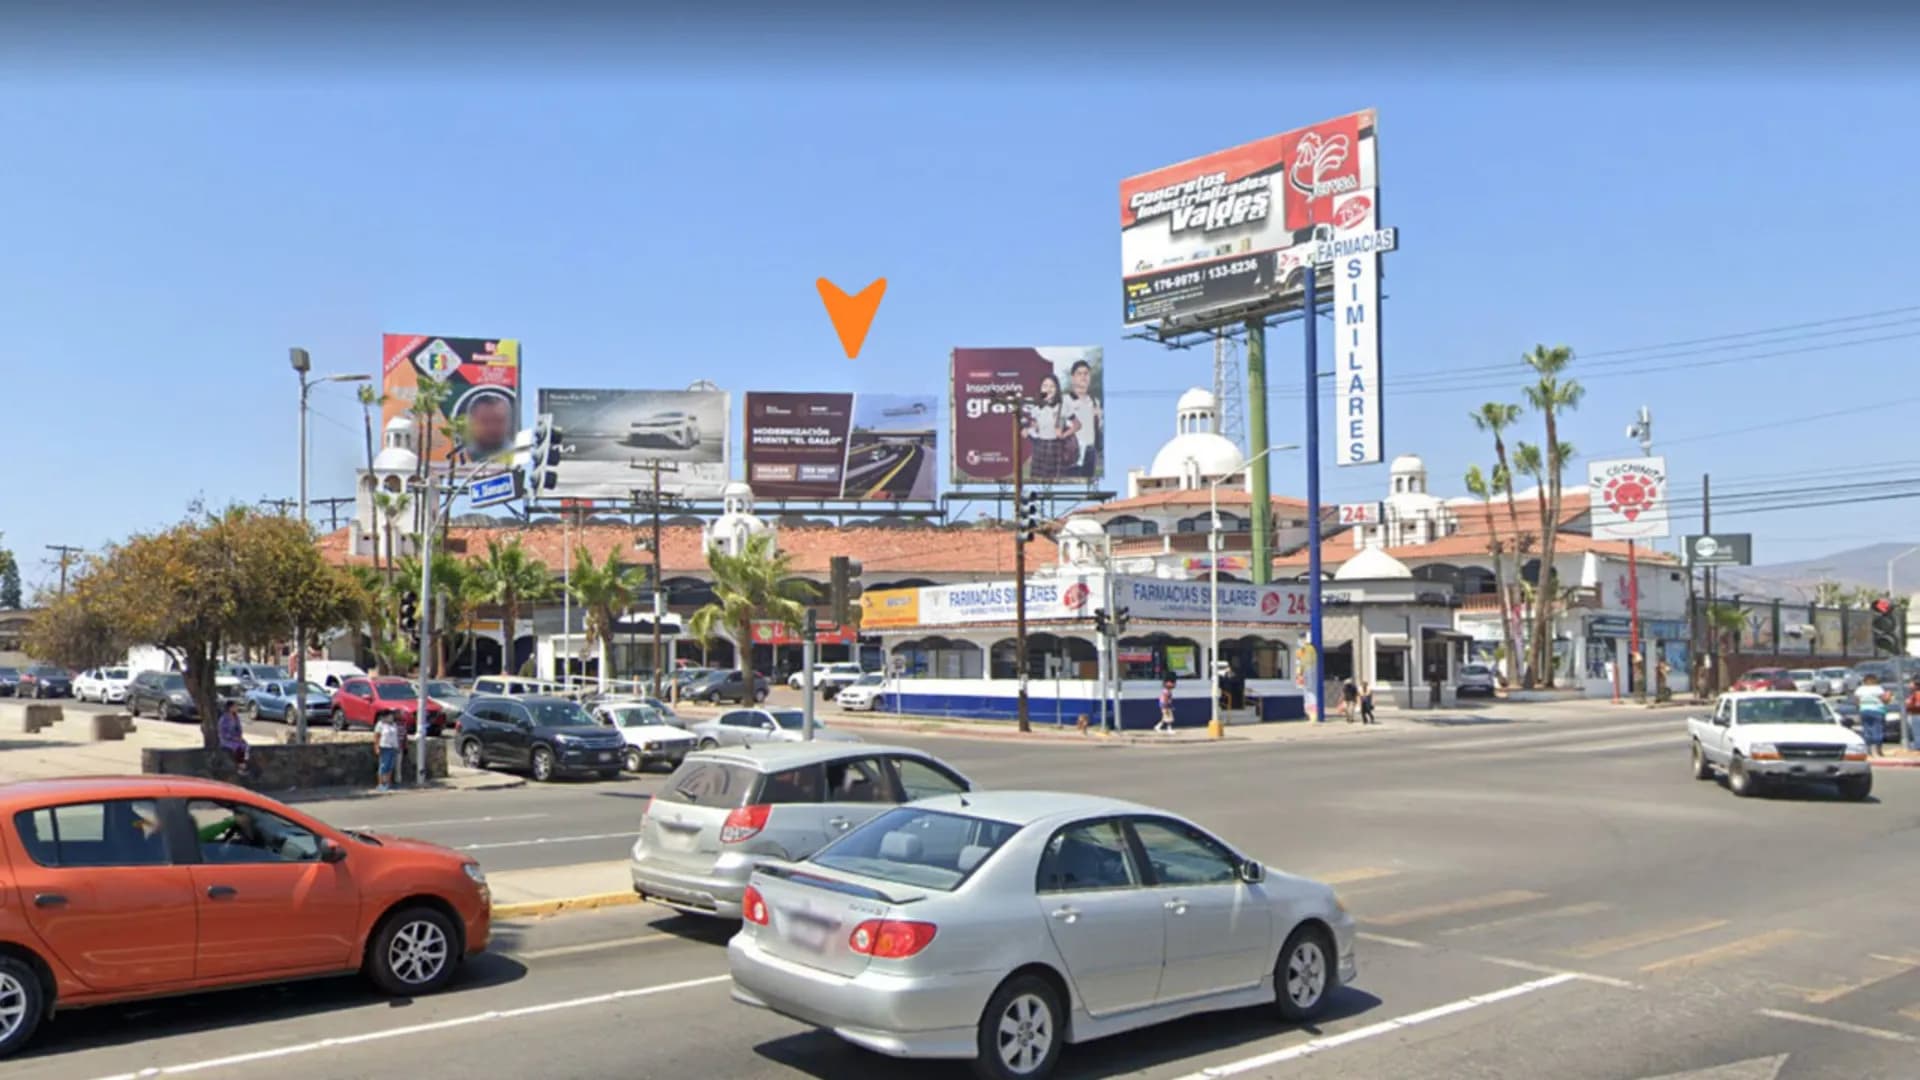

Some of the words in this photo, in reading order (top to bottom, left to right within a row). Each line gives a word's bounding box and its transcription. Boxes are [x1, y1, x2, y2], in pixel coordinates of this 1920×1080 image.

[1130, 172, 1226, 209] Concretos
[1137, 175, 1270, 220] Industrializados
[1318, 230, 1391, 260] FARMACIAS
[1346, 259, 1365, 462] SIMILARES
[966, 382, 1024, 394] Inscripción
[753, 426, 830, 436] MODERNIZACIÓN
[1343, 506, 1366, 523] 24
[1004, 585, 1058, 604] SILARES
[1133, 583, 1198, 605] FARMACIAS
[1200, 585, 1257, 607] SIILARES
[1287, 593, 1306, 615] 24
